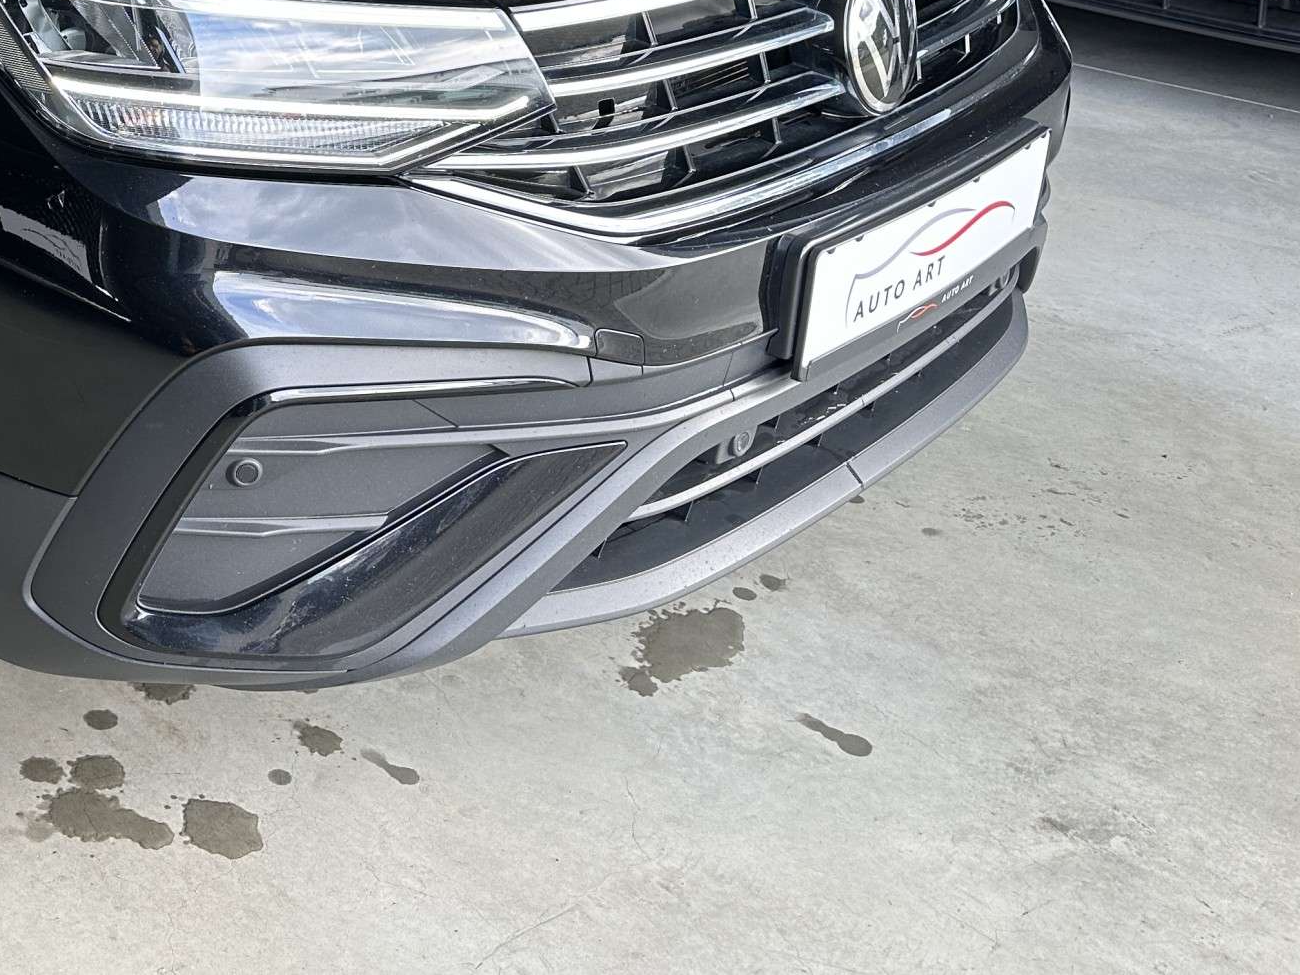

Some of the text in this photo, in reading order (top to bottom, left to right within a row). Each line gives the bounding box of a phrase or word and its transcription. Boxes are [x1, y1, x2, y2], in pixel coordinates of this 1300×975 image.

[852, 255, 946, 323] AUTO ART
[941, 274, 975, 304] AUTO ART
